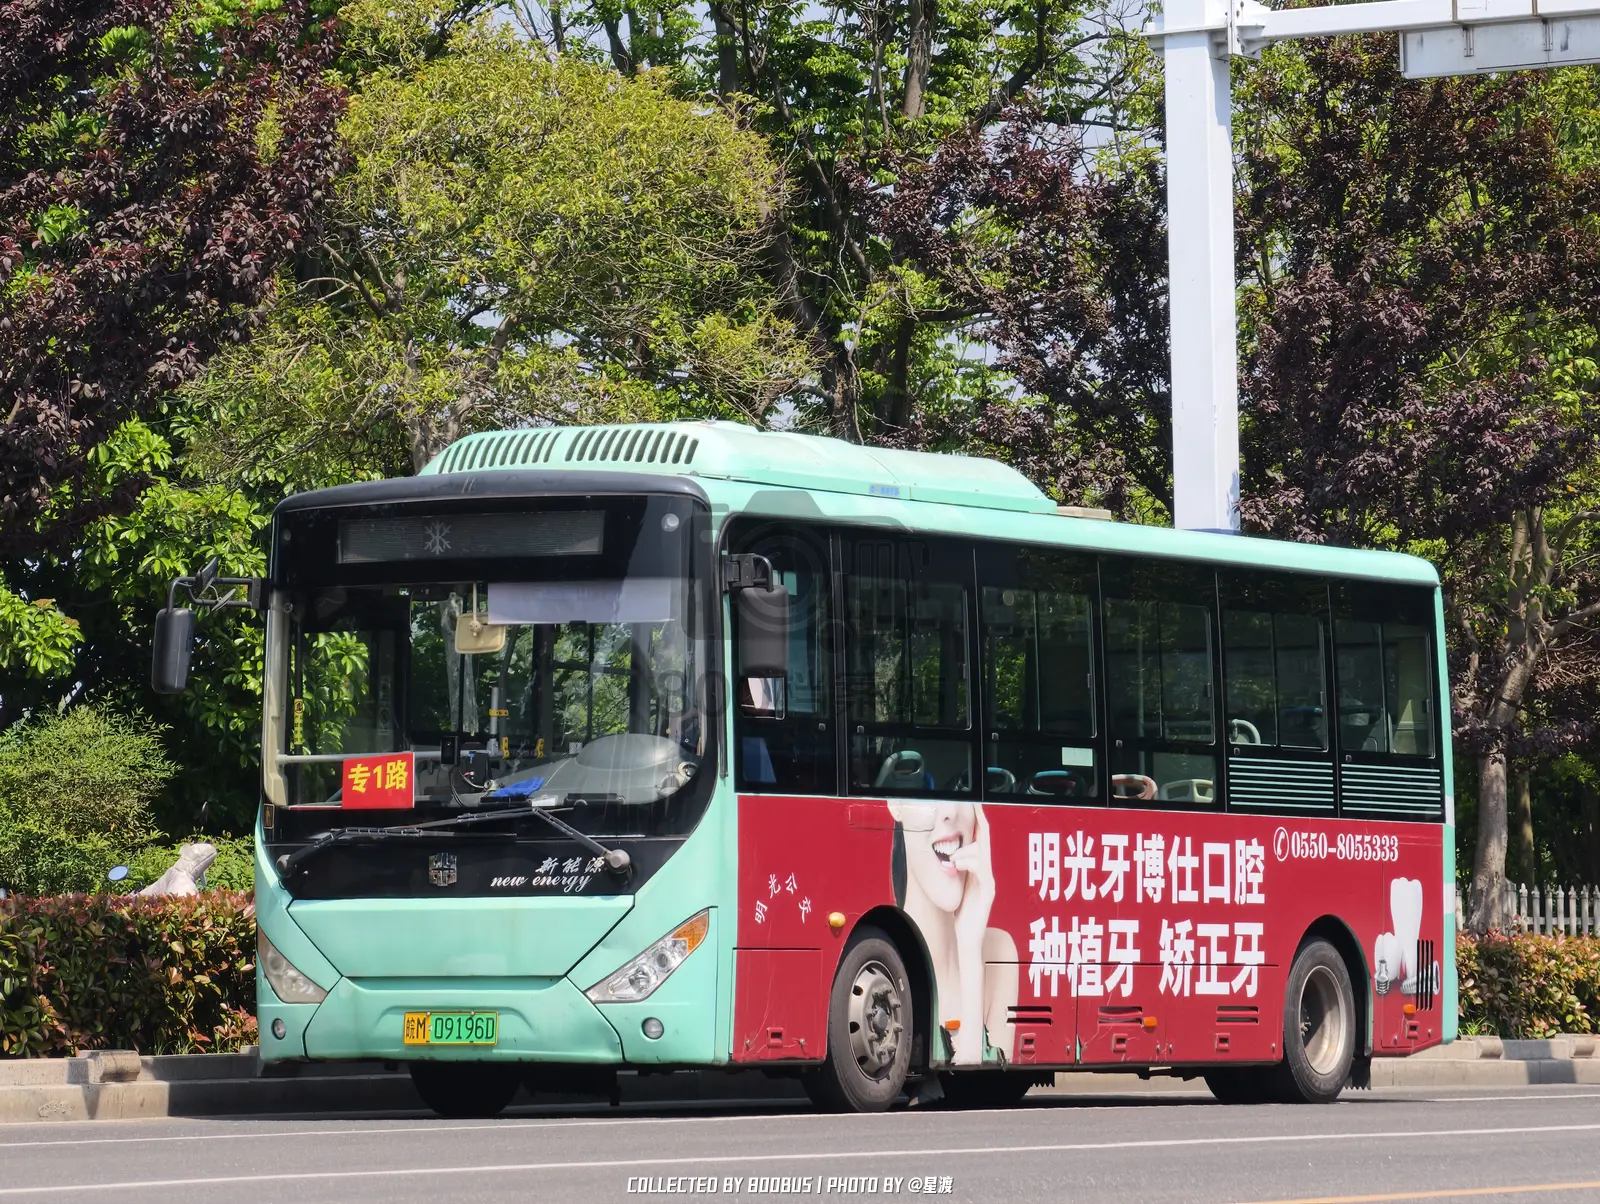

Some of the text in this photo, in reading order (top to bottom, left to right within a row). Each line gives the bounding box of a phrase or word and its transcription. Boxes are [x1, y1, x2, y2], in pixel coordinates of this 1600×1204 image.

[348, 760, 408, 793] 专1路
[1291, 831, 1399, 862] 0550-8055333
[535, 857, 604, 874] 新能源
[1028, 831, 1265, 905] 明光牙博仕口腔
[490, 875, 592, 893] new energy
[1028, 916, 1265, 997] 种植牙 矫正牙
